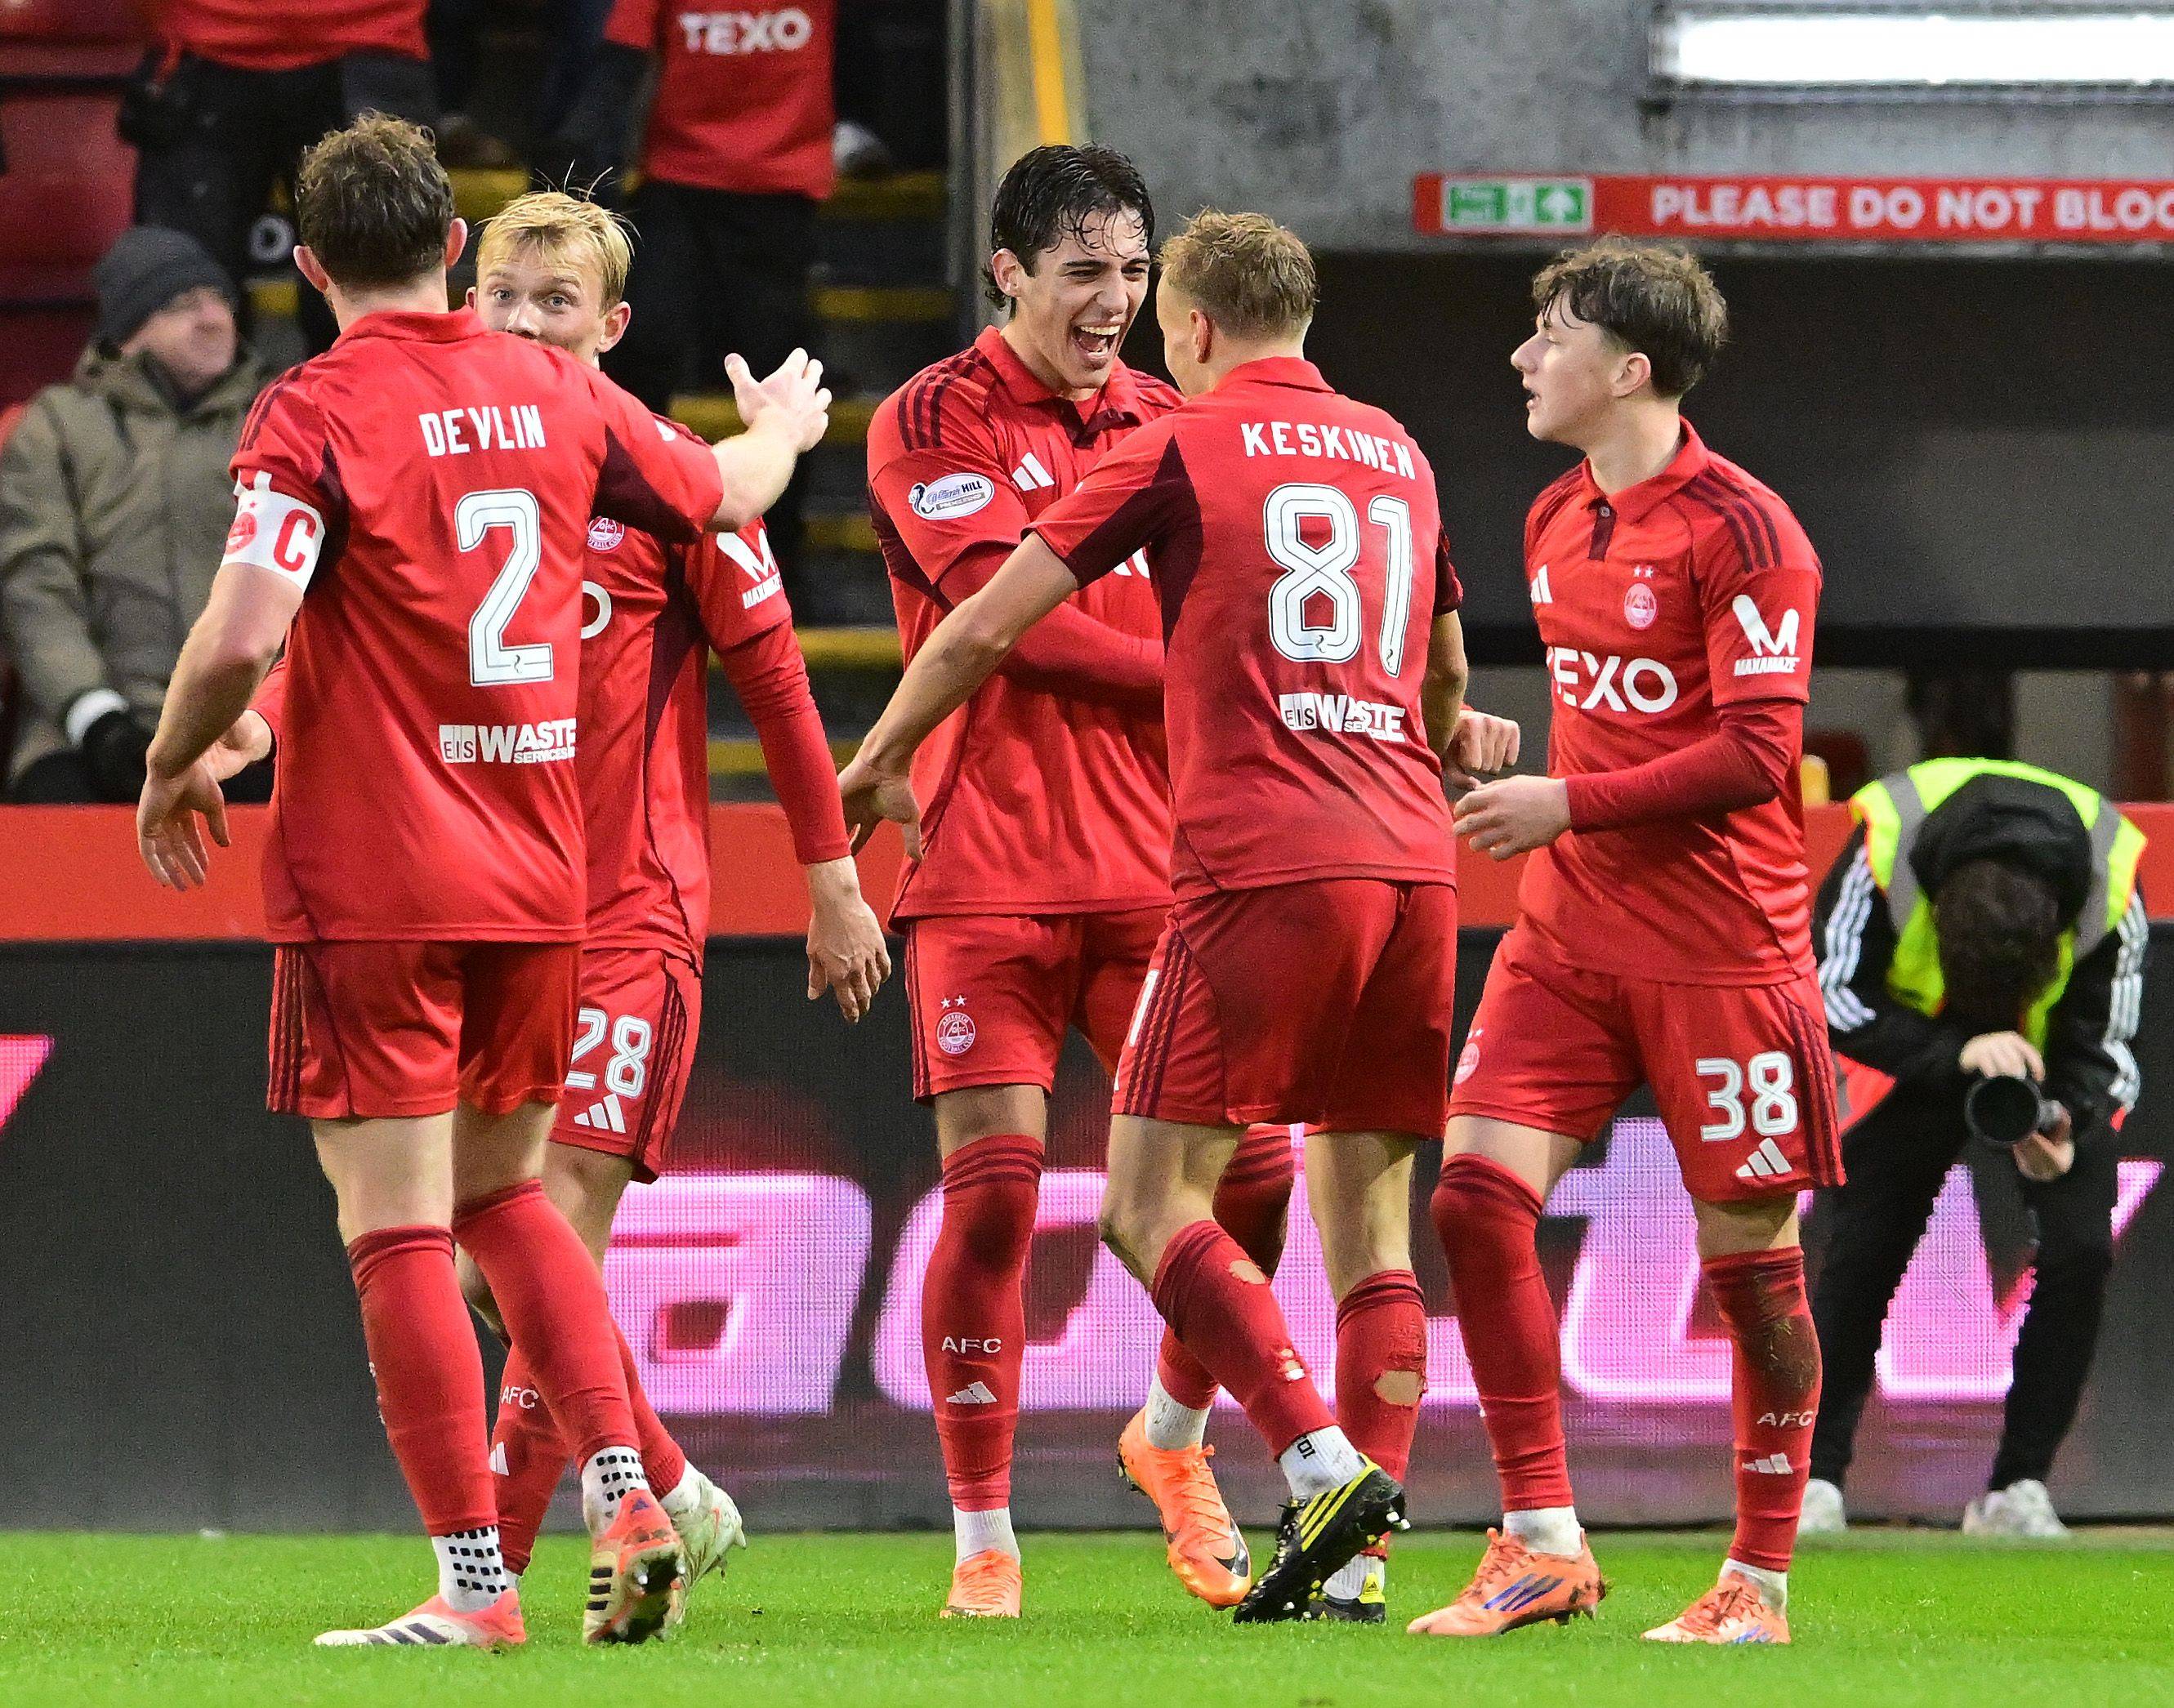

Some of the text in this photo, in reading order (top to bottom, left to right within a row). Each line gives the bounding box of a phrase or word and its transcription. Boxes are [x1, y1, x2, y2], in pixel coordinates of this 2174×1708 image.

[679, 7, 812, 55] TEXO
[1652, 185, 1837, 227] PLEASE
[1850, 185, 1925, 230] DO
[1936, 187, 2042, 230] NOT
[418, 404, 547, 457] DEVLIN
[1240, 421, 1417, 481] KESKINEN
[961, 480, 983, 493] HILL
[273, 508, 317, 573] C
[454, 488, 555, 688] 2
[1262, 482, 1413, 679] 81
[1547, 646, 1678, 713] EXO
[1313, 694, 1406, 743] WASTE
[565, 1007, 653, 1099] 28
[1695, 1050, 1798, 1143] 38
[941, 1336, 1002, 1354] AFC
[501, 1385, 539, 1410] AFC
[1757, 1411, 1814, 1427] AFC
